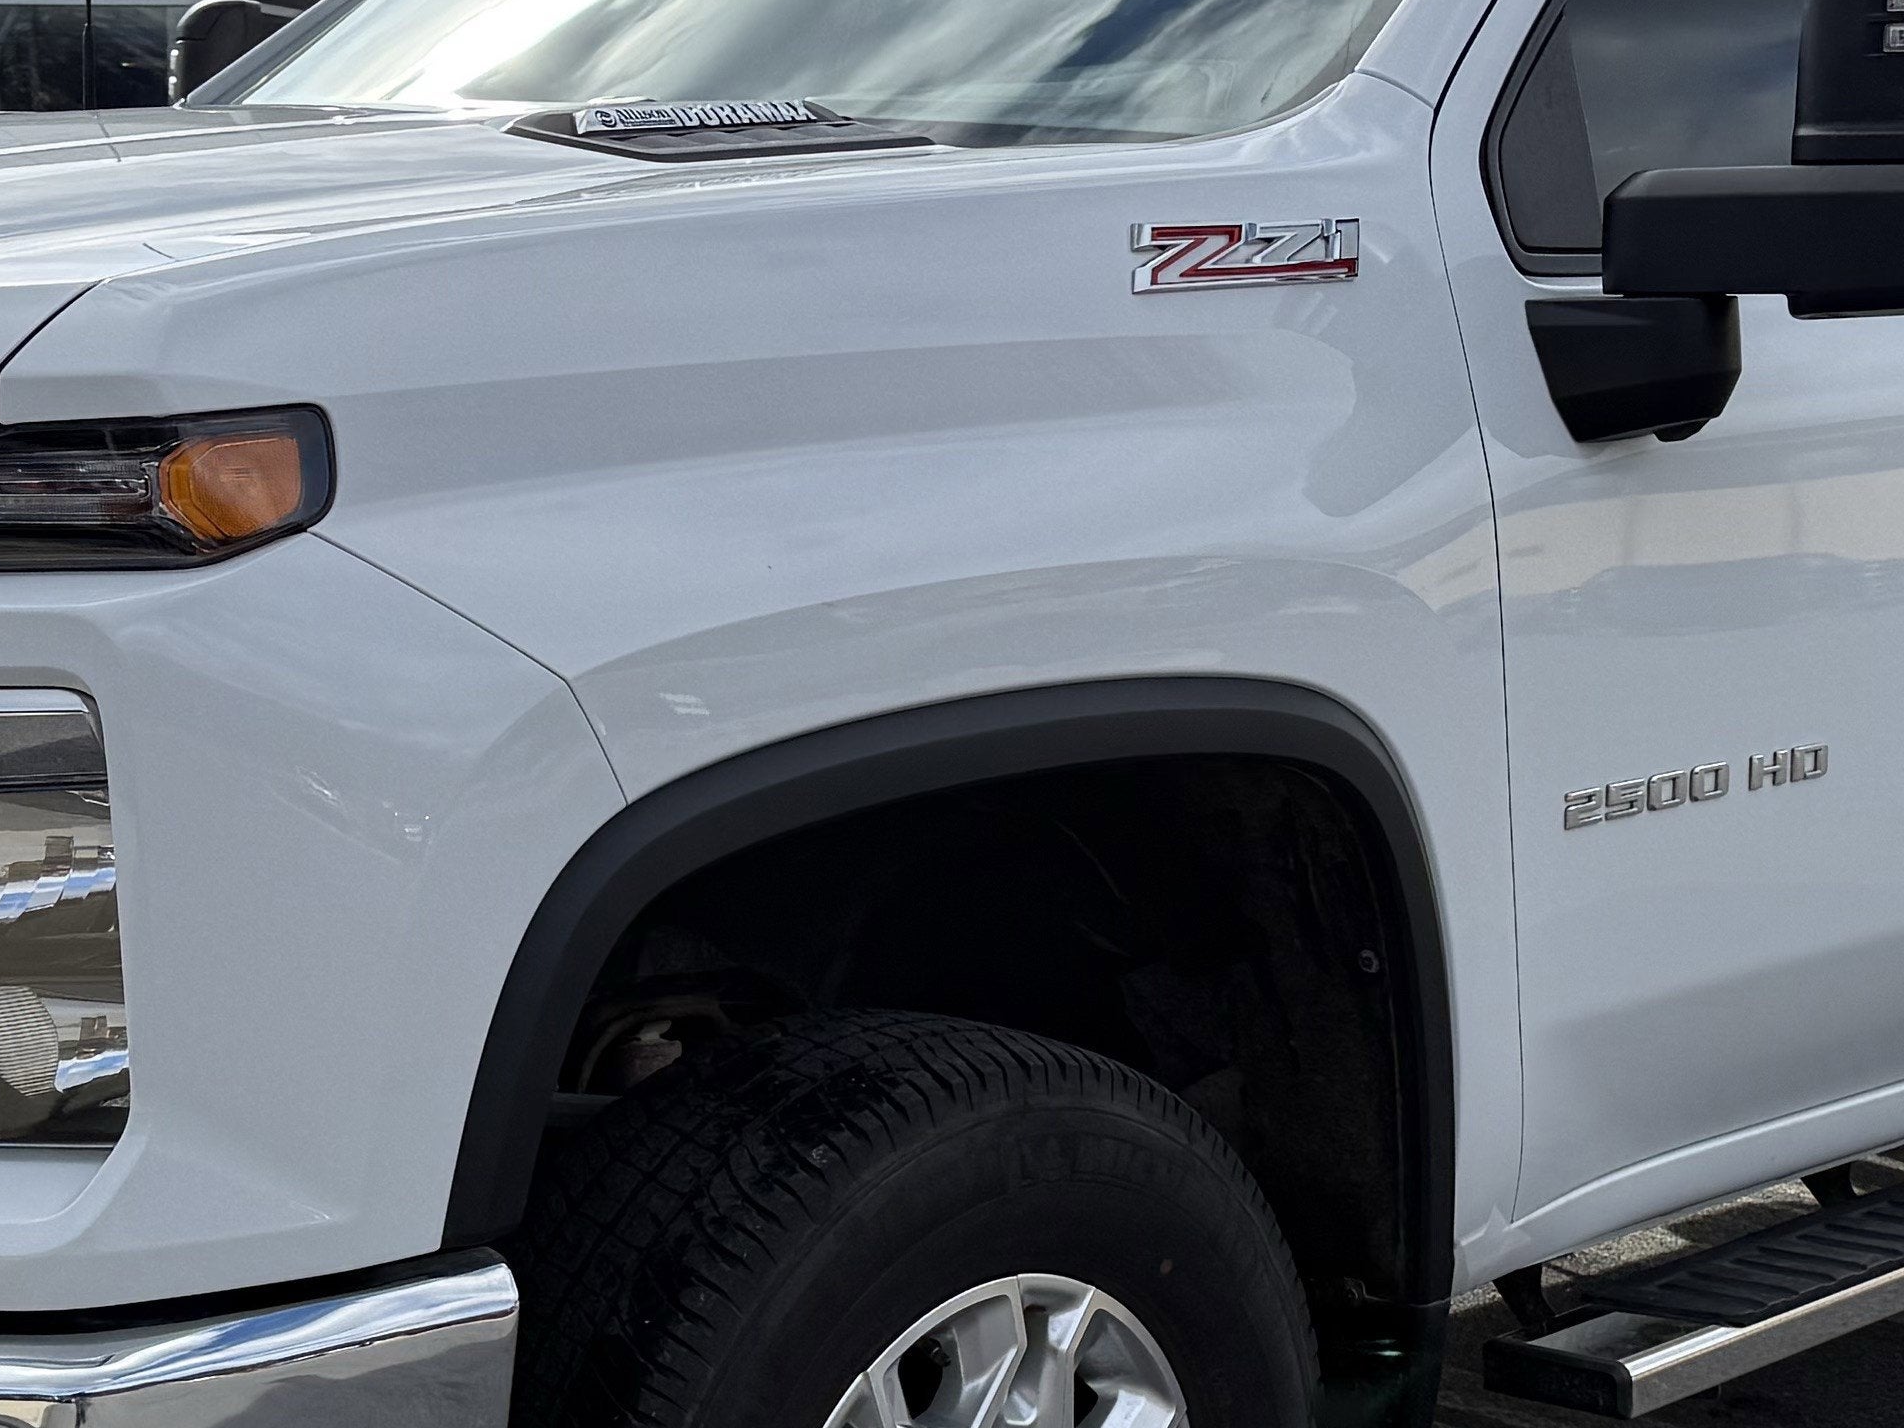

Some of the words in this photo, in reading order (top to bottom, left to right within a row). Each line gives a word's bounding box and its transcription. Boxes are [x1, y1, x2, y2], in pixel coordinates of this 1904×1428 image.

[680, 100, 818, 127] DURAMAX
[1131, 218, 1360, 294] Z71
[1563, 761, 1731, 831] 2500
[1748, 743, 1829, 792] HD
